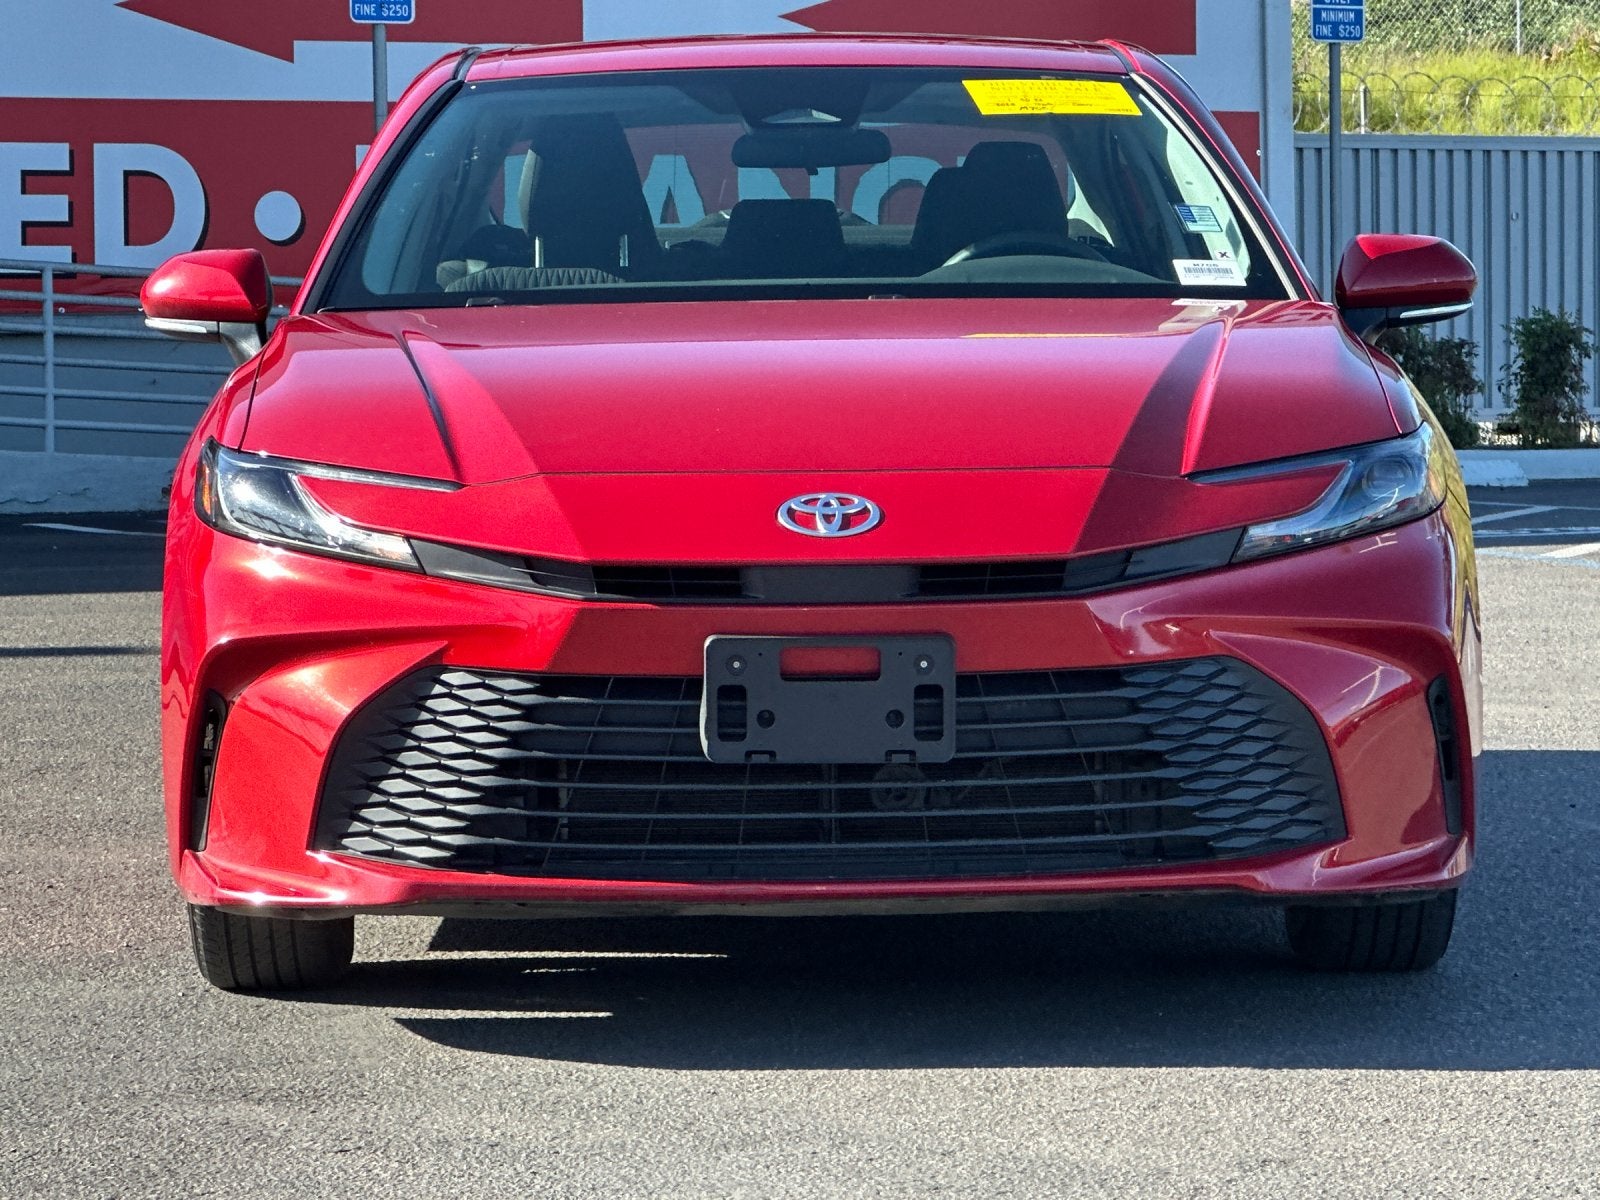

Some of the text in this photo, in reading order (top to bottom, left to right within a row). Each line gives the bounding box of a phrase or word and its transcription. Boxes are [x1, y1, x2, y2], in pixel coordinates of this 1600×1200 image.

[354, 3, 409, 17] FINE $250
[1321, 9, 1355, 22] MINIMUM
[1315, 24, 1361, 38] FINE $250
